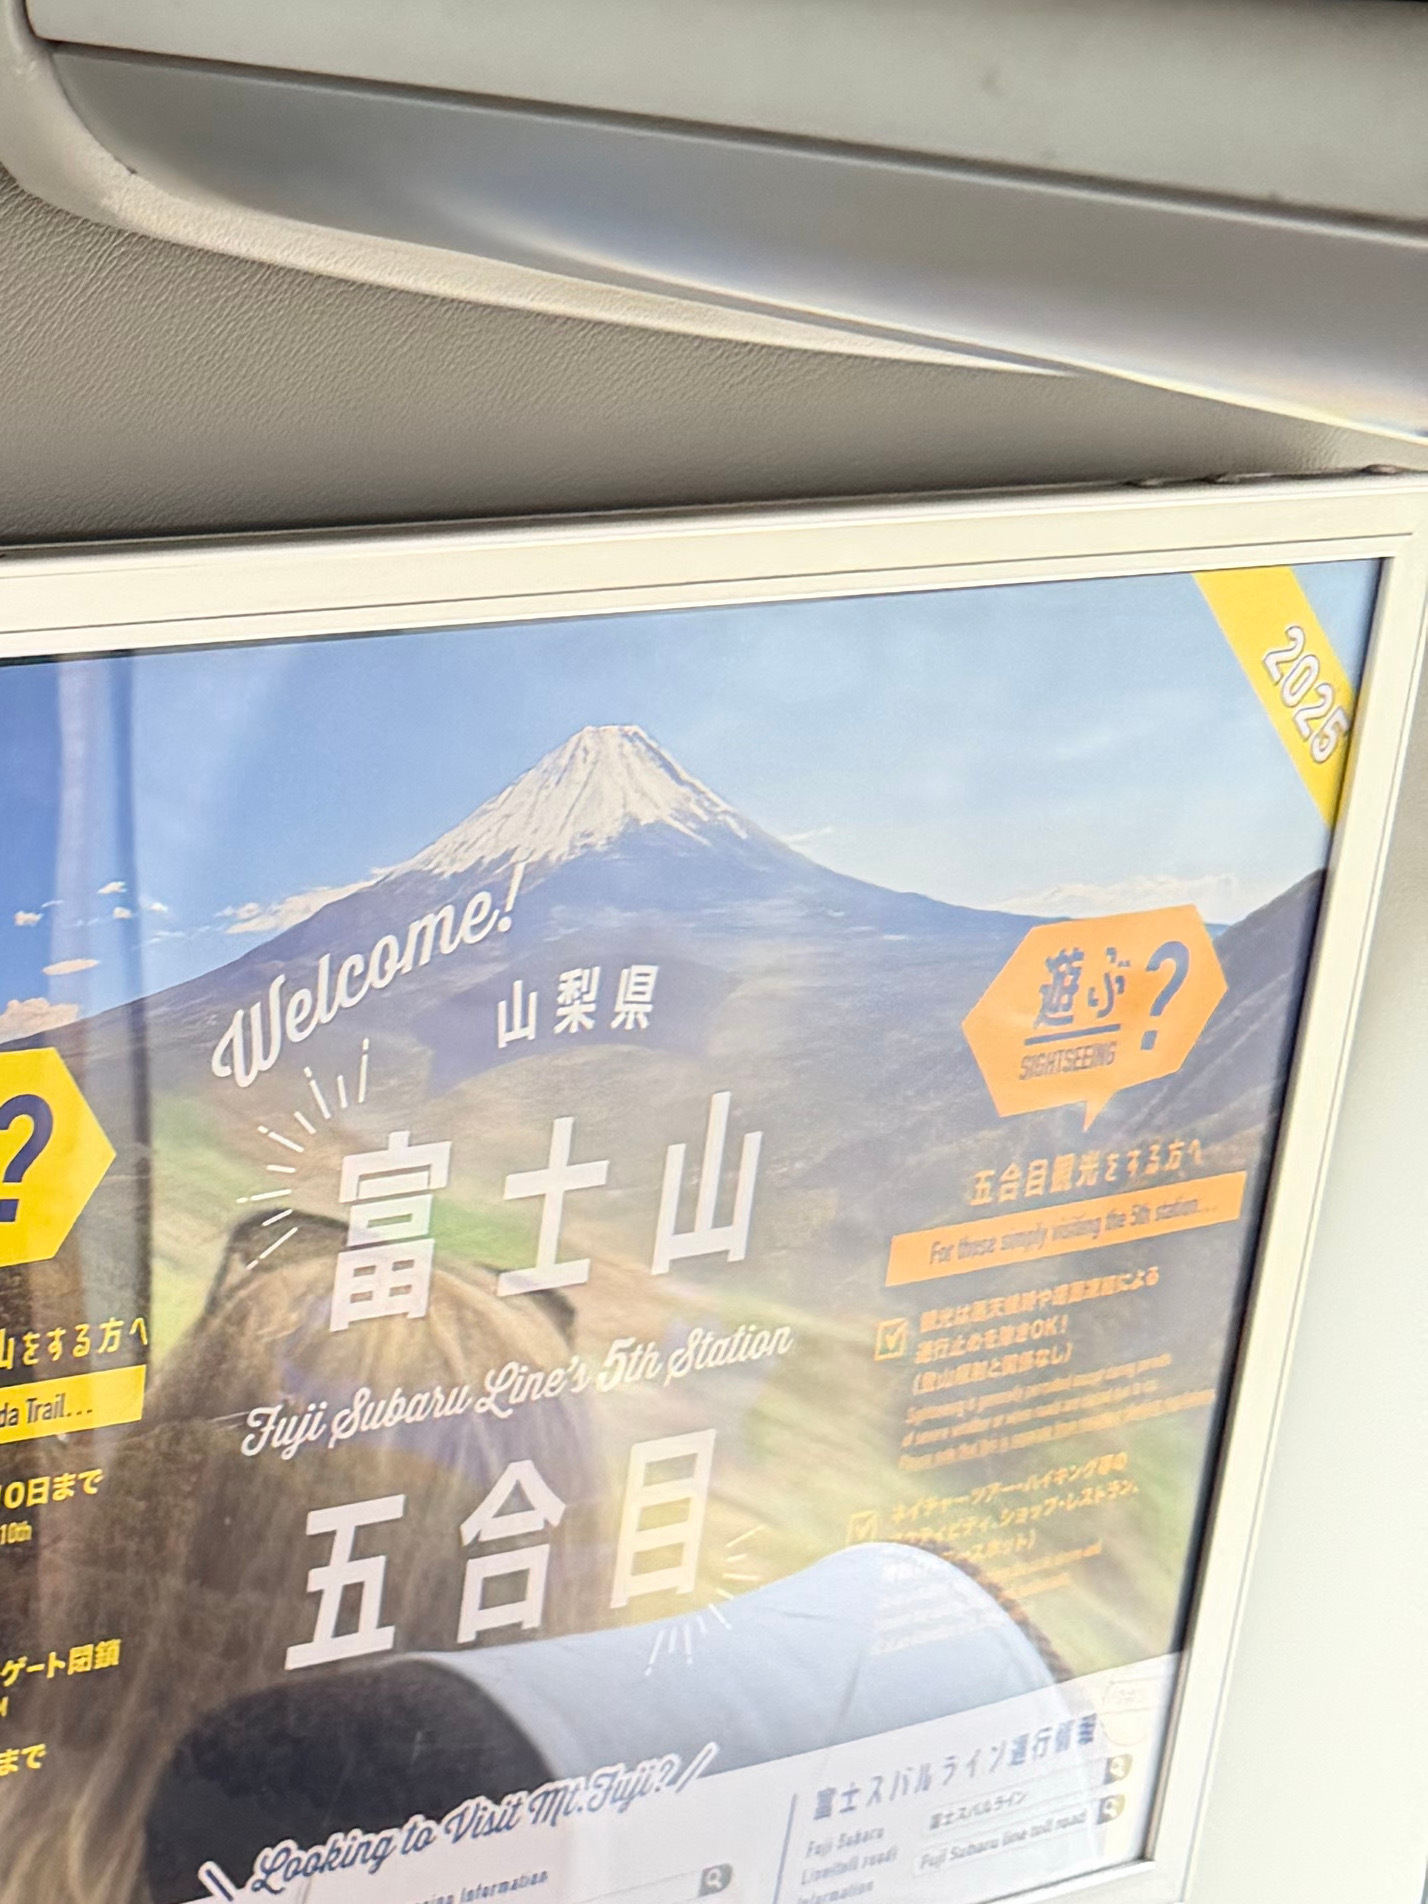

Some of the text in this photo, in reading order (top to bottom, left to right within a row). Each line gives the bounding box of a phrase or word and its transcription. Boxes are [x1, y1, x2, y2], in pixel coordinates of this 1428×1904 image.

[1261, 624, 1350, 765] 2025
[211, 860, 527, 1088] Welcome!
[497, 965, 659, 1048] 山梨県
[329, 1090, 763, 1333] 富士山
[241, 1325, 794, 1461] Fuji Subaru Line's 5th Station
[0, 1520, 33, 1546] 10th
[284, 1428, 717, 1671] 五合目
[251, 1834, 396, 1895] Looking
[398, 1820, 438, 1857] to
[443, 1799, 524, 1844] Visit
[459, 1870, 549, 1904] Information
